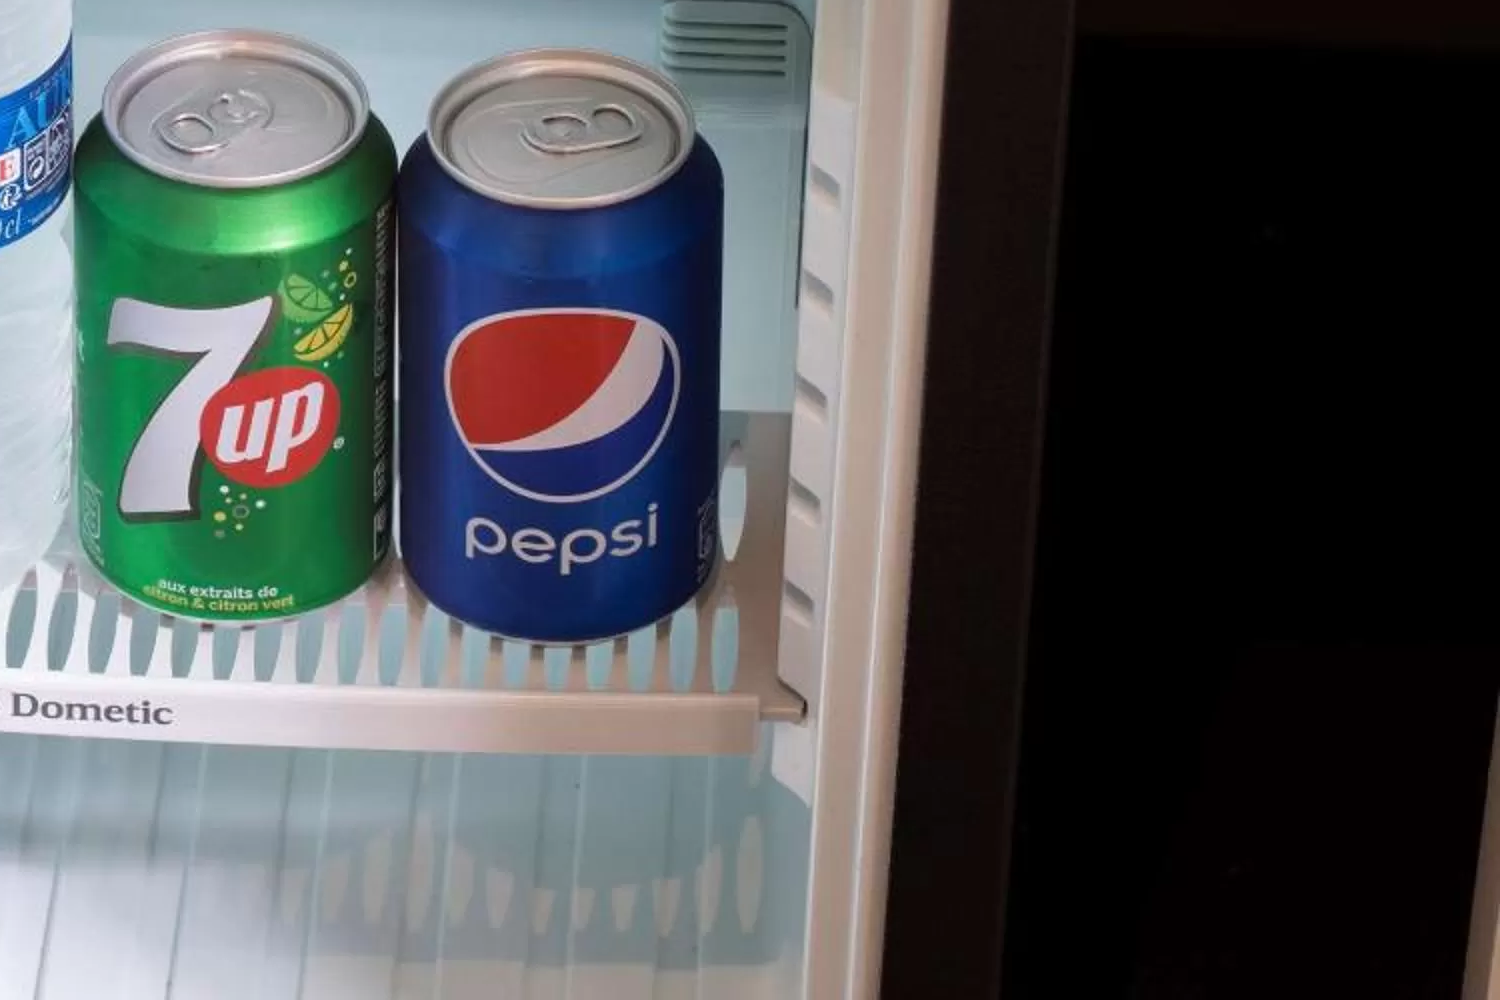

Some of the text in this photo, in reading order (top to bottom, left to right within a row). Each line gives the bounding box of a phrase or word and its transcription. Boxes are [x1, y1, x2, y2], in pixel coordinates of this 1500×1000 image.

[464, 502, 659, 576] pepsi
[141, 584, 189, 606] citron
[208, 598, 259, 612] citron
[262, 594, 295, 610] vert
[157, 578, 279, 599] aux extraits de
[11, 691, 174, 726] Dometic
